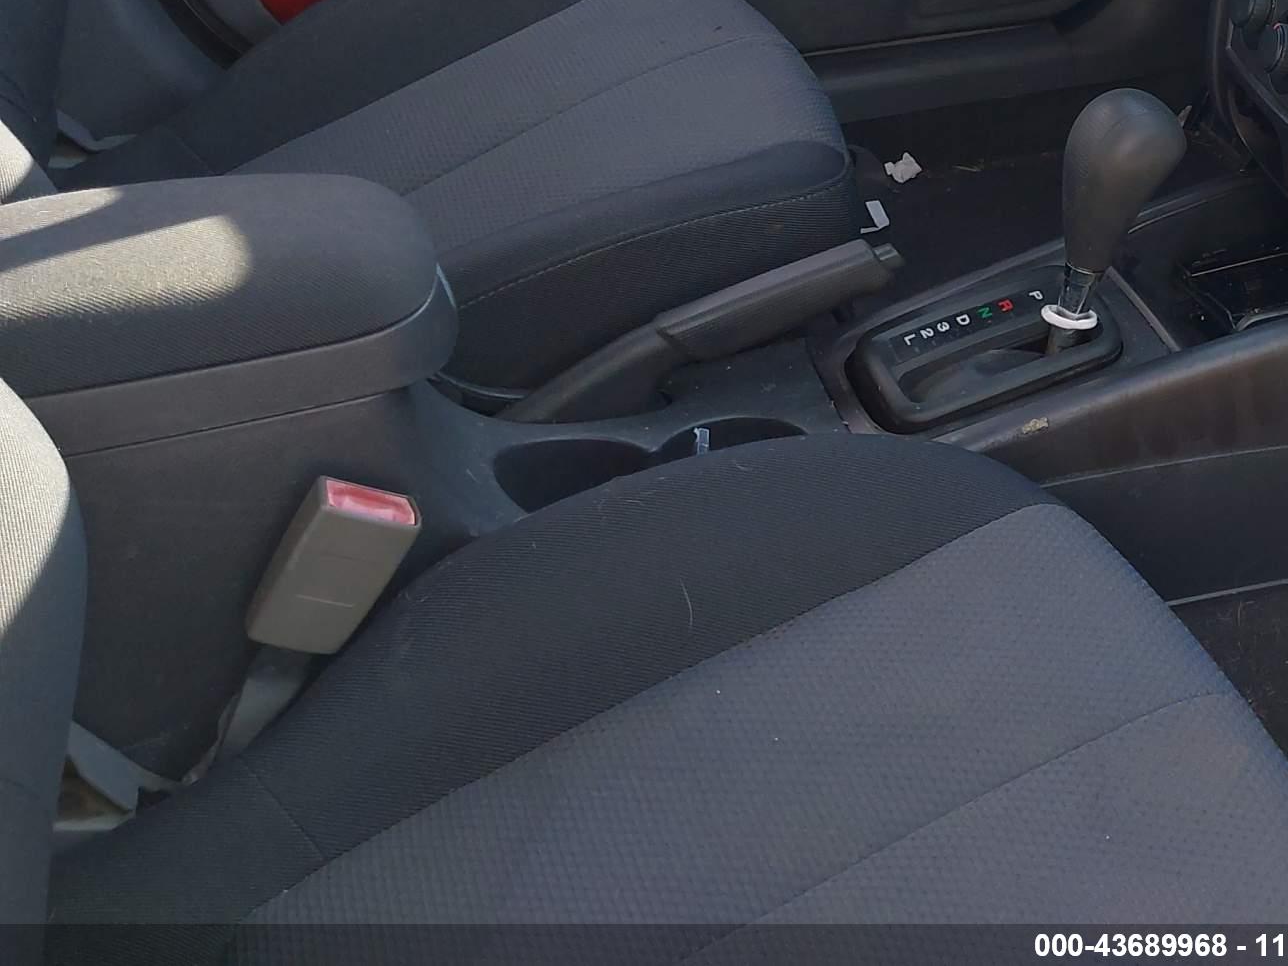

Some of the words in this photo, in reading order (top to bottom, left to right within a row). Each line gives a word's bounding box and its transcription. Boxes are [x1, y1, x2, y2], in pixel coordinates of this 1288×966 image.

[1028, 289, 1044, 301] P
[997, 298, 1014, 312] R
[977, 306, 993, 319] N
[955, 313, 971, 326] D
[919, 328, 935, 339] 2
[936, 321, 950, 333] 3
[903, 333, 917, 346] L
